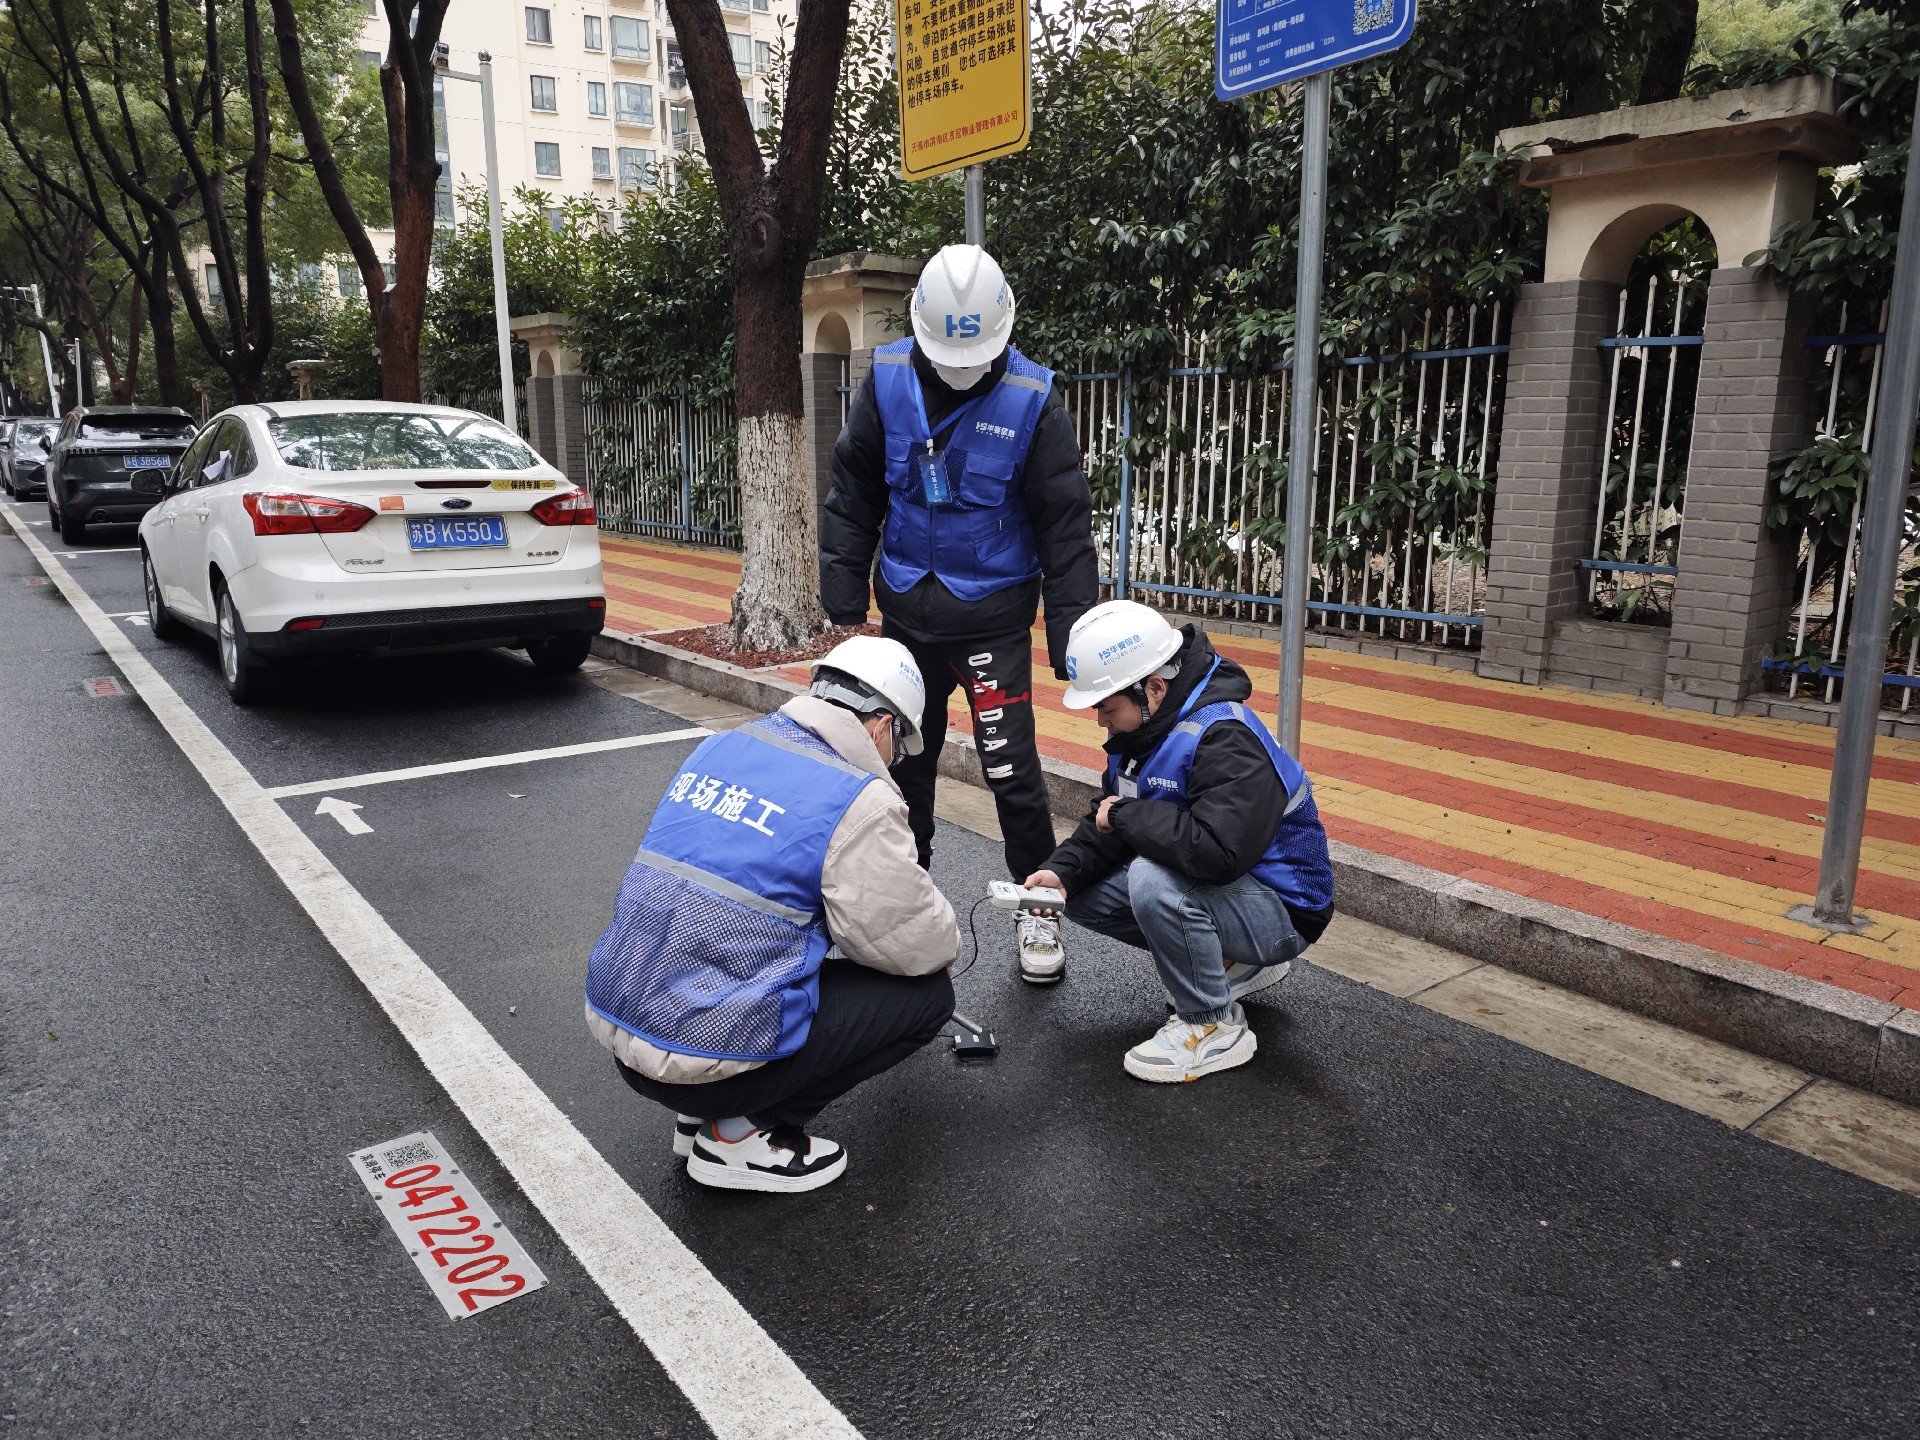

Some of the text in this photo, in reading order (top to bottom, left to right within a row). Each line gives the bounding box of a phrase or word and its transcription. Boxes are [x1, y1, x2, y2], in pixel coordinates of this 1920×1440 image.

[908, 78, 964, 109] 他停车场停车。
[945, 313, 981, 339] HS
[511, 480, 541, 490] 保持车距
[1066, 655, 1078, 681] S
[668, 771, 786, 837] 现场施工
[384, 1164, 526, 1312] 0472202
